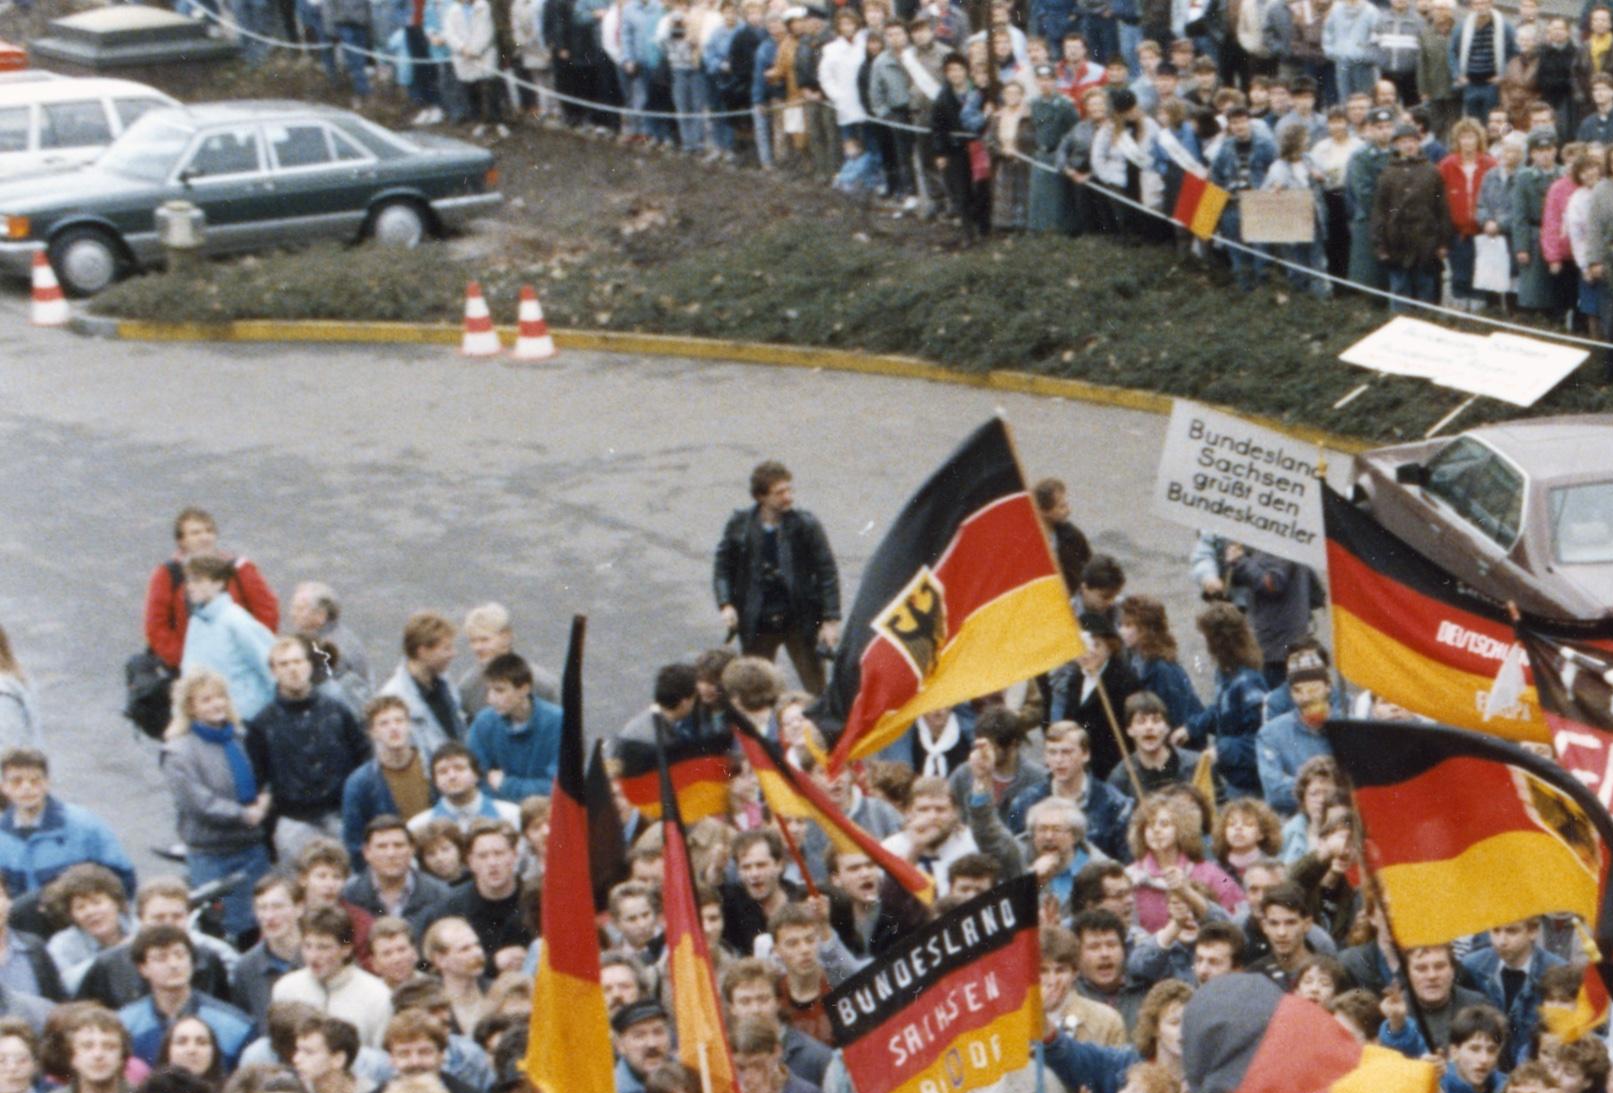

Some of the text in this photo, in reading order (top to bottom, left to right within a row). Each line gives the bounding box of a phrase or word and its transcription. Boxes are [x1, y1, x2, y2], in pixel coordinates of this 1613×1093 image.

[1188, 418, 1325, 479] Bundesland
[1197, 447, 1305, 497] Sachsen
[1166, 481, 1317, 545] Bundeskanzler
[1192, 472, 1300, 517] grüßt den
[836, 898, 1017, 1026] BUNDESLAND
